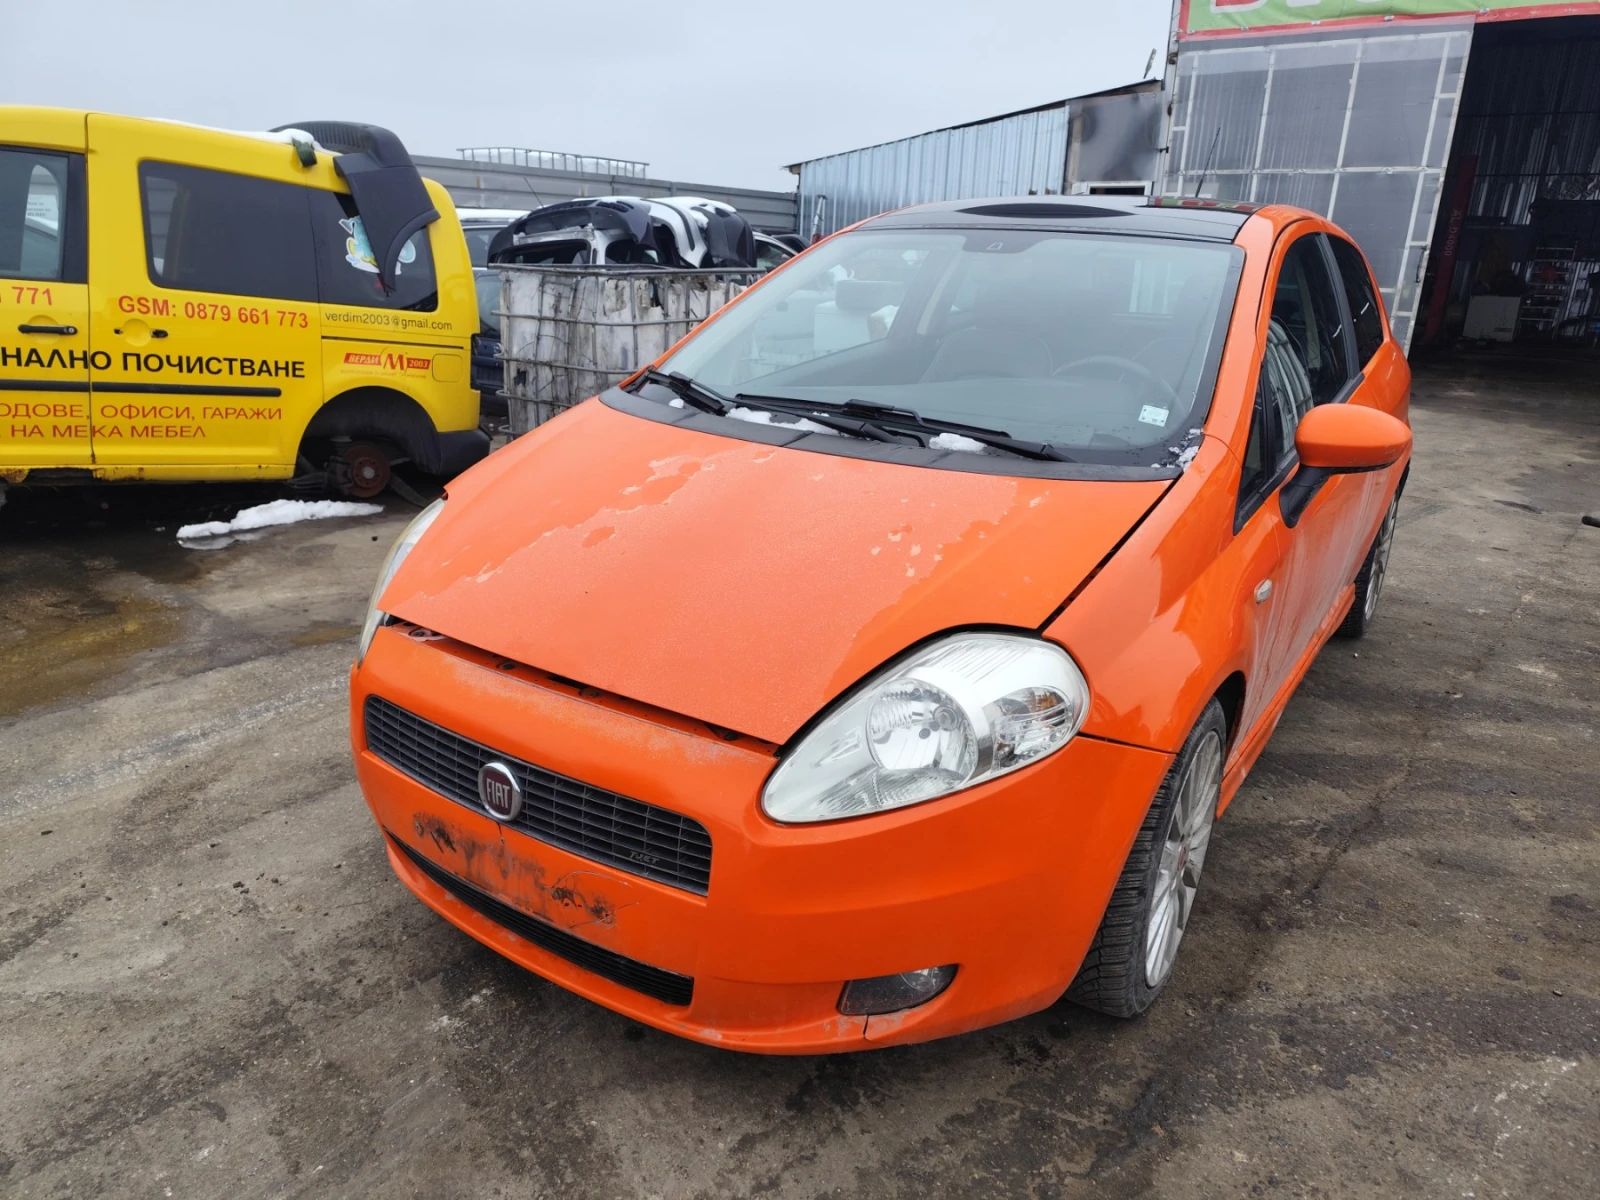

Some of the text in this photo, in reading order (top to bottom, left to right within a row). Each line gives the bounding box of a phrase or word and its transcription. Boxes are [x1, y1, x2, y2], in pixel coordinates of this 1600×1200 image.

[12, 286, 52, 306] 771
[118, 295, 309, 329] GSM: 0879 661 773
[325, 312, 453, 330] verdim2003@gmail.com
[1, 347, 306, 378] НАЛНО ПОЧИСТВАНЕ
[409, 359, 428, 368] 2003
[100, 404, 196, 421] ОФИСИ,
[203, 407, 282, 420] ГАРАЖИ
[11, 424, 206, 438] НА МЕКА МЕБЕЛ
[486, 778, 510, 809] FIAT
